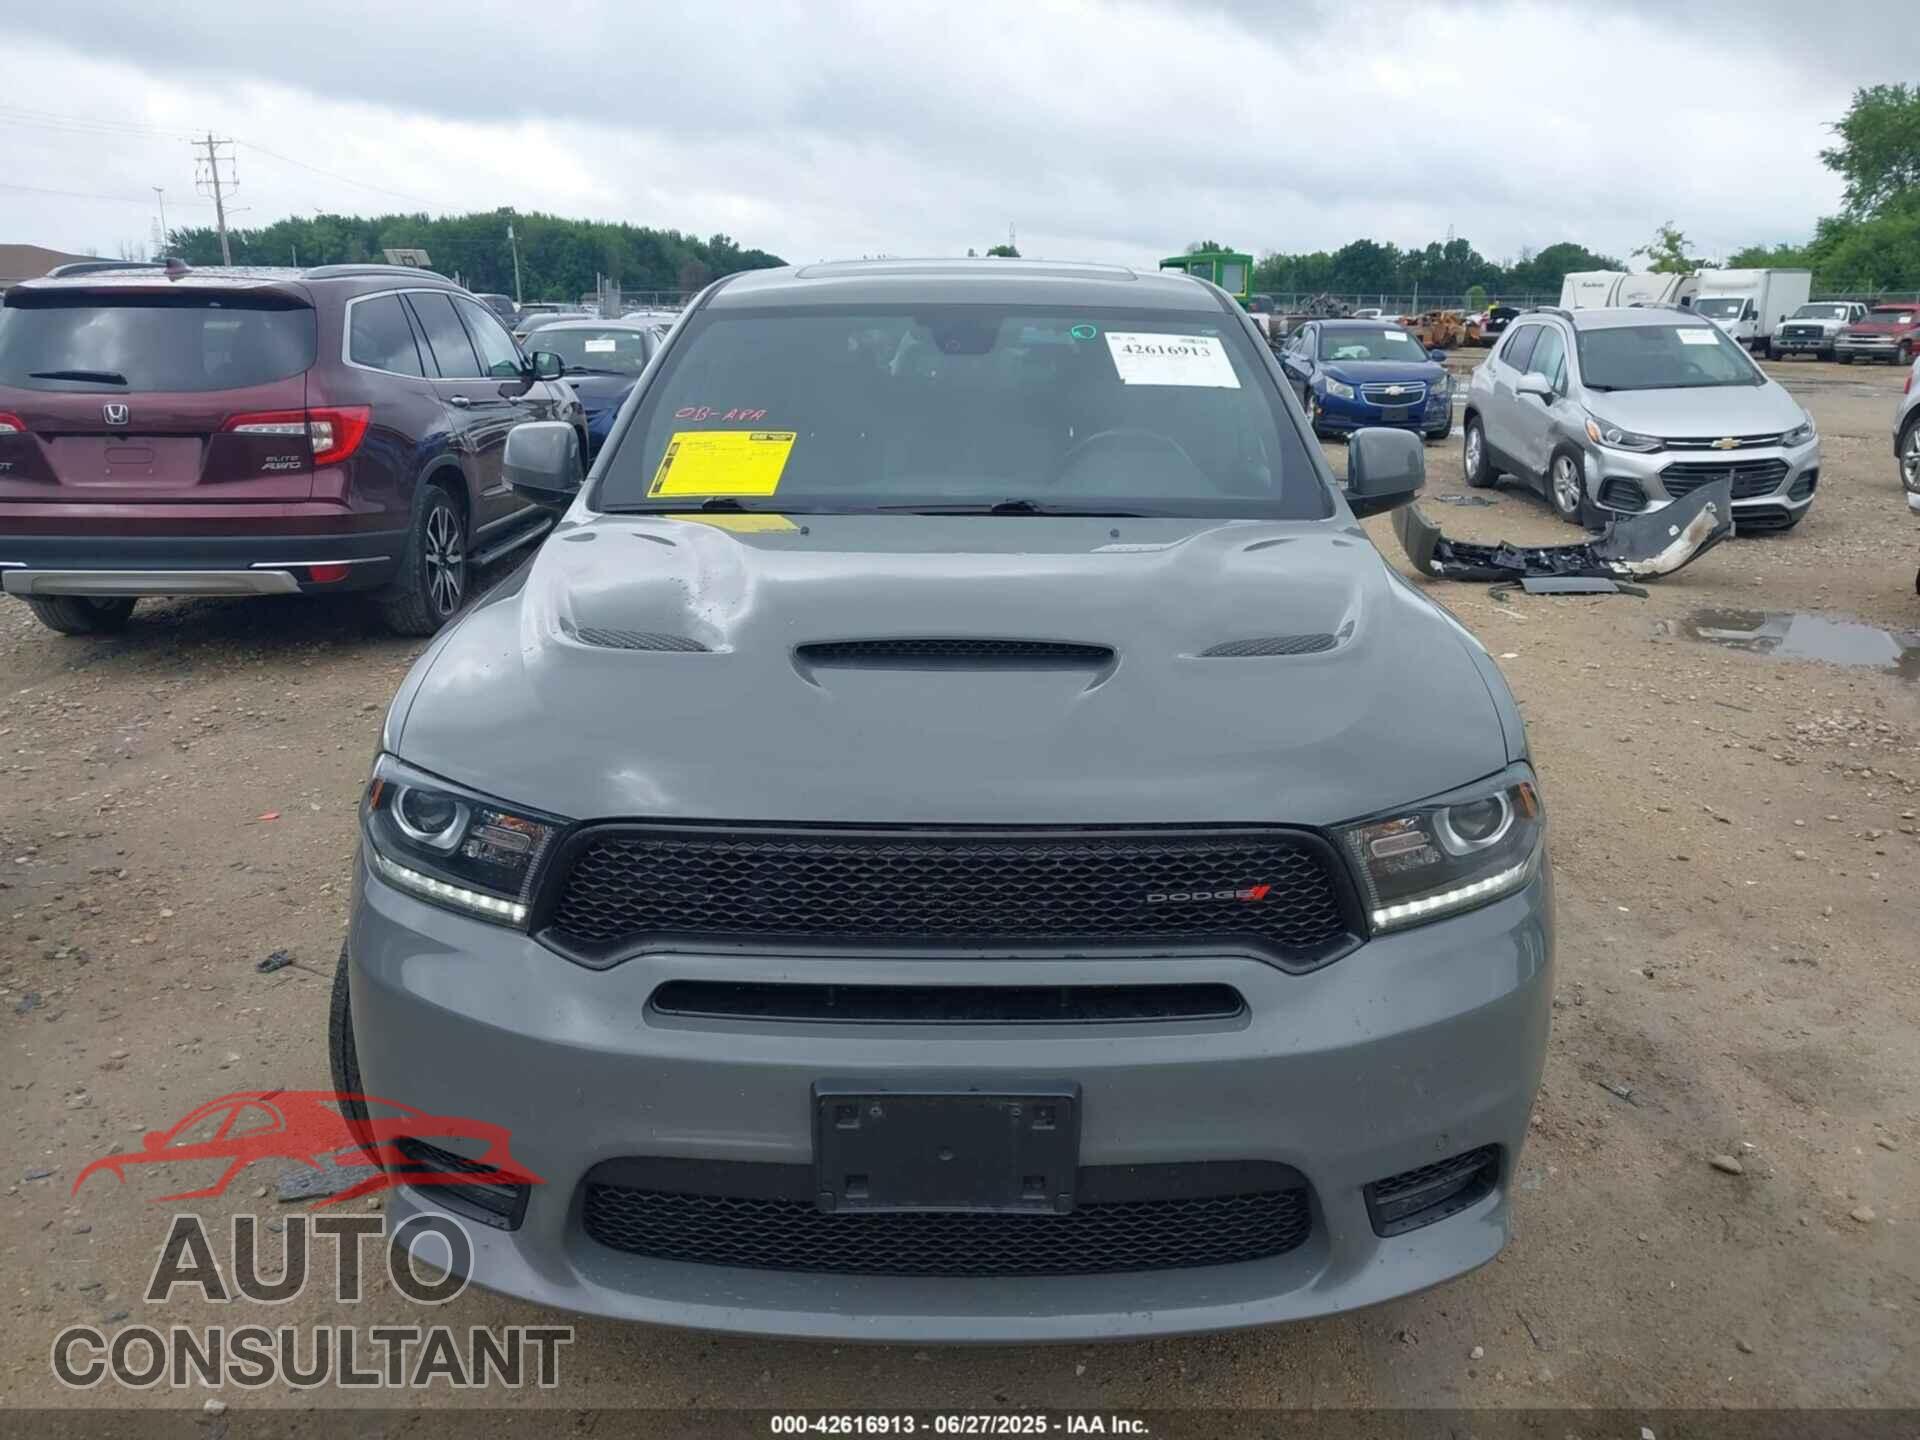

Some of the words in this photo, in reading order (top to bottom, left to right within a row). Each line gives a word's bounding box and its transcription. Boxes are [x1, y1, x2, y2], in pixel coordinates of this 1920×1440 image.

[1122, 343, 1211, 358] 42616913
[261, 461, 302, 470] AWD
[1146, 889, 1254, 902] DODGE
